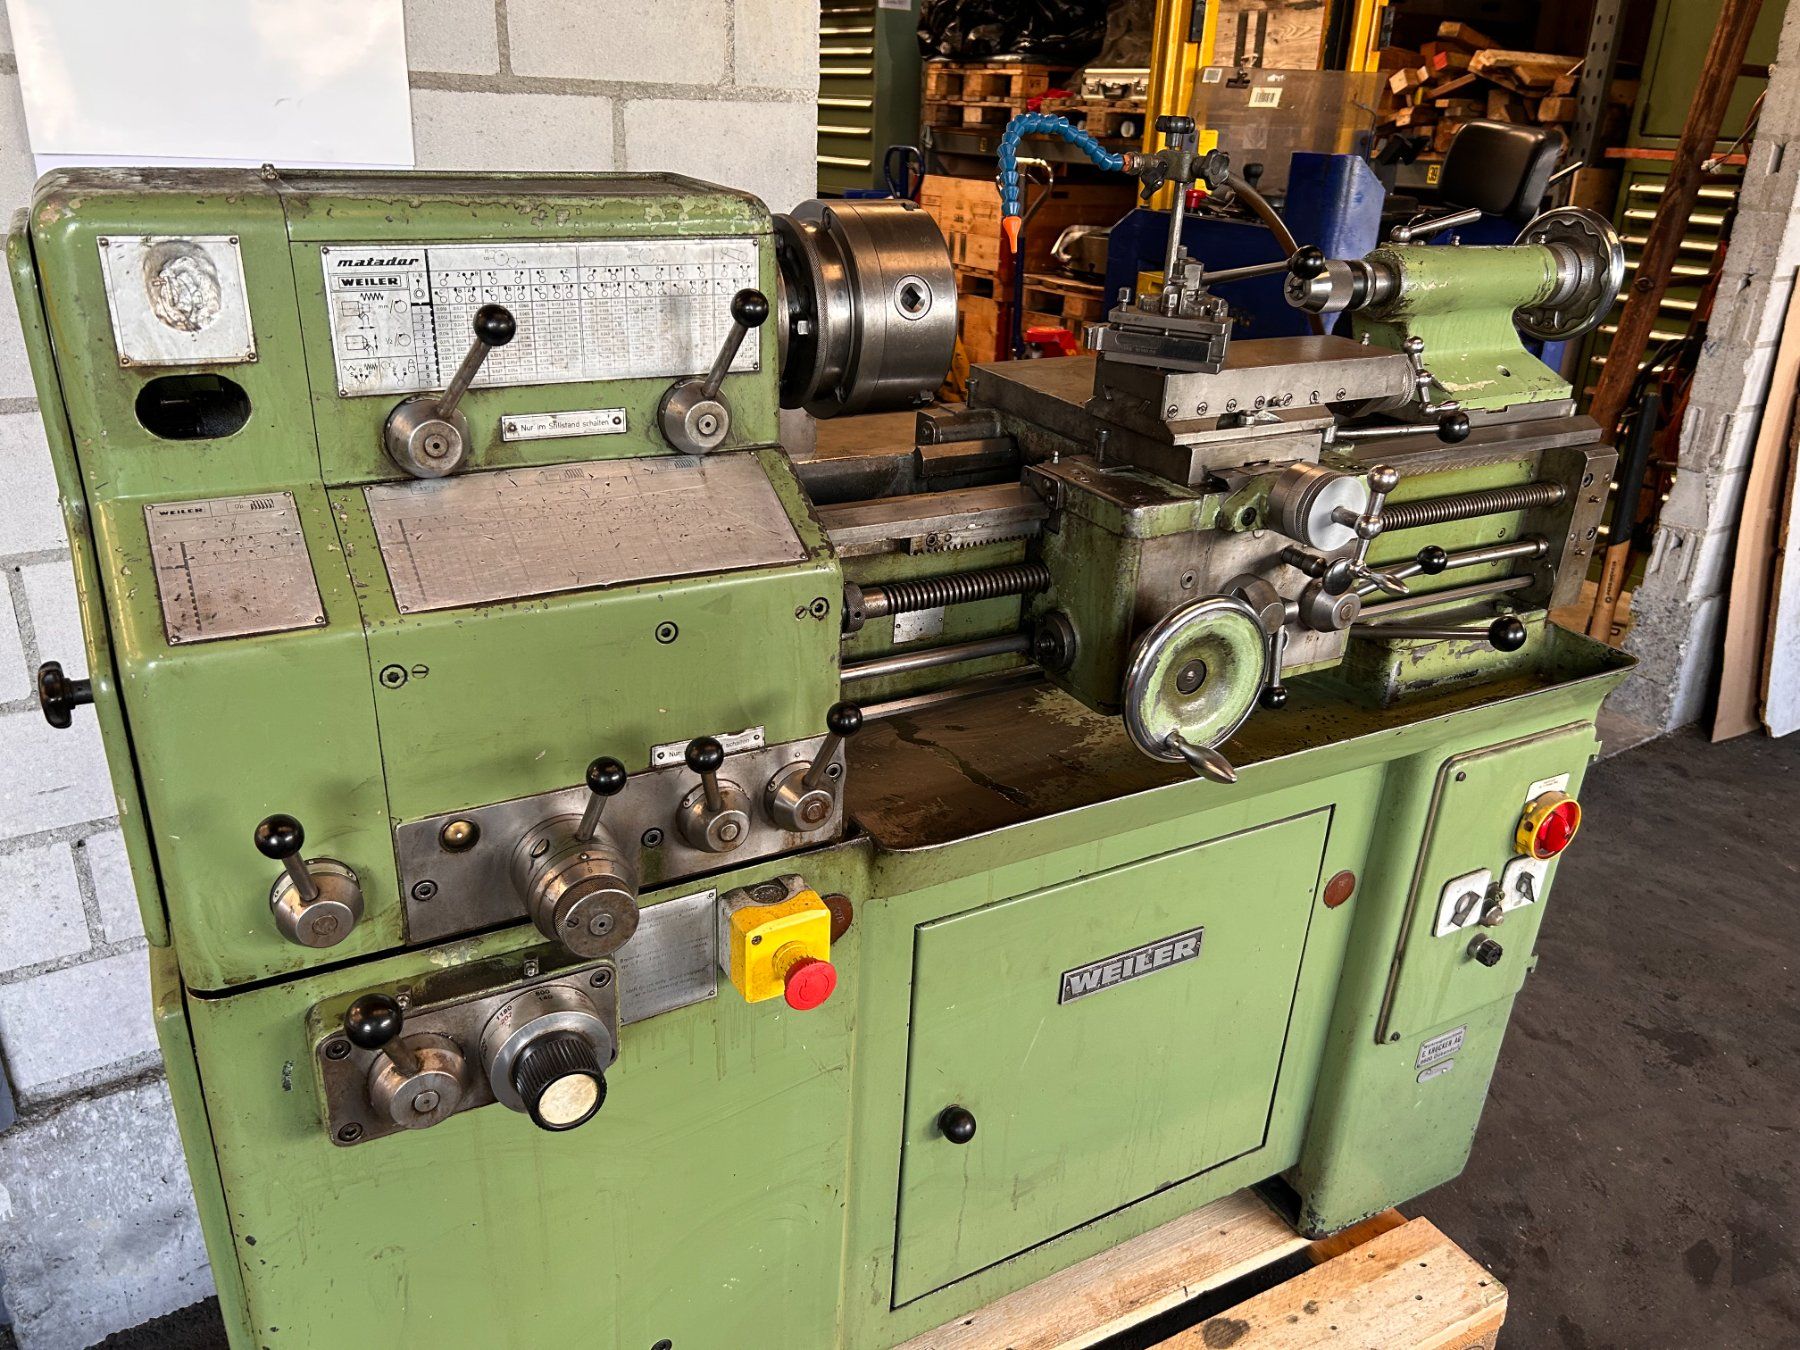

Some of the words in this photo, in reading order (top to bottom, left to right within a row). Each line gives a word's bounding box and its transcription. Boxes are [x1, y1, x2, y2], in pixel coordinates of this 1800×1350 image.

[337, 257, 419, 267] matador
[341, 277, 398, 286] WEILER
[549, 420, 580, 430] Stillstand
[583, 417, 609, 427] schalten
[158, 508, 203, 516] WEILER
[1069, 938, 1197, 995] WEILER
